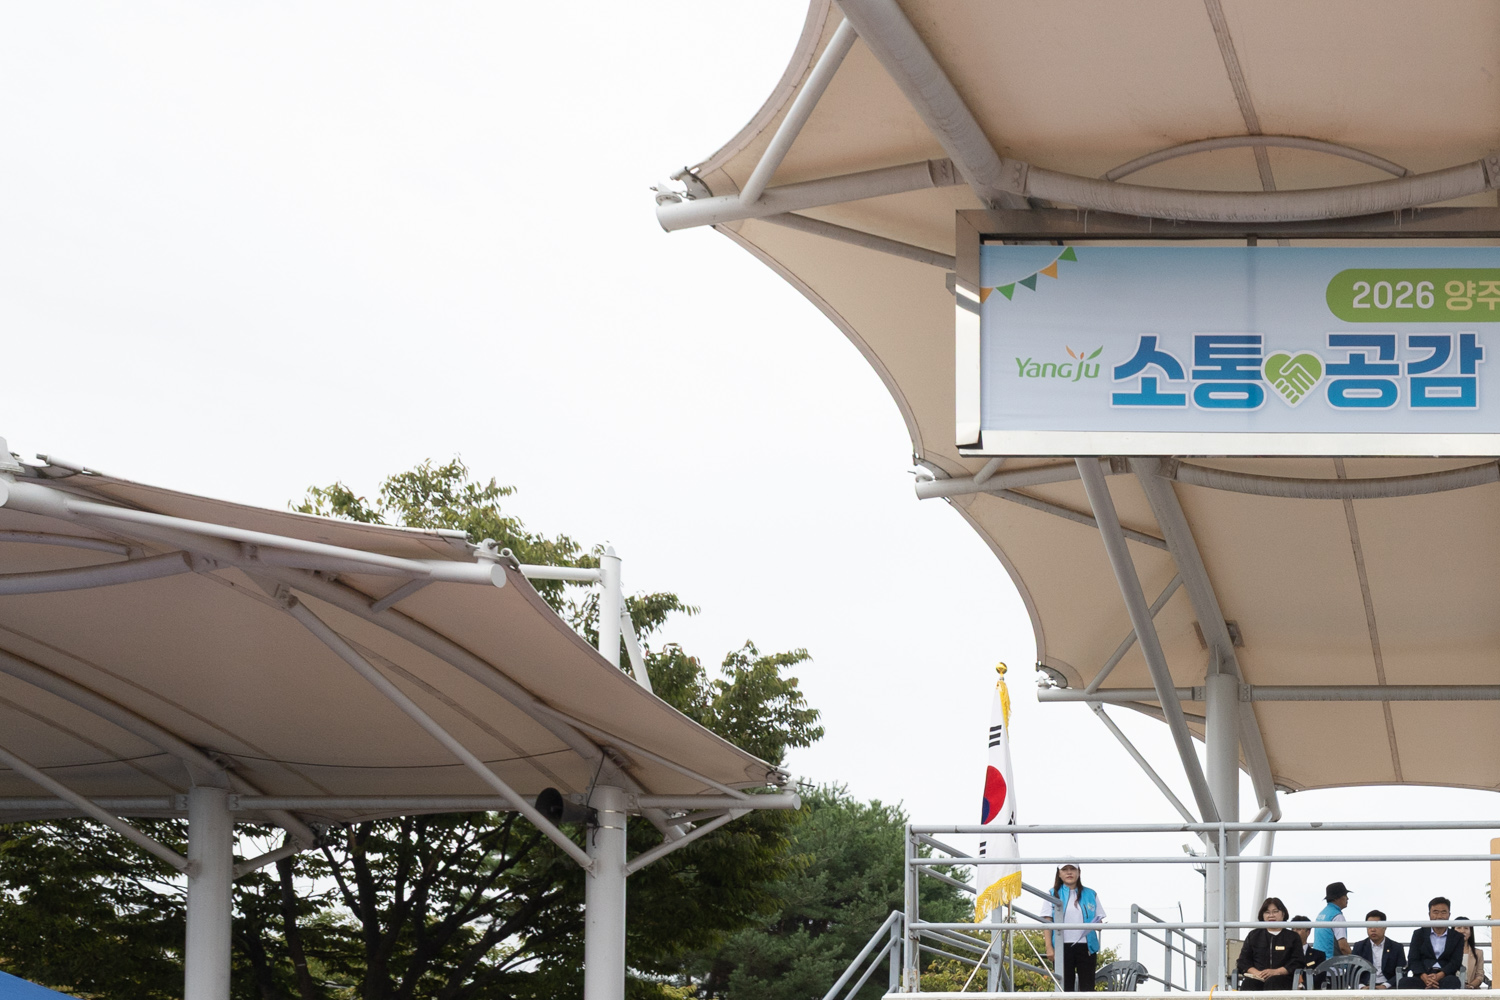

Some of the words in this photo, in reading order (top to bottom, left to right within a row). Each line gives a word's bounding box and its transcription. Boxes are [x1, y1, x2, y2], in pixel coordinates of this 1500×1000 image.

[1352, 280, 1435, 310] 2026
[1015, 356, 1101, 382] Yangju
[1111, 333, 1266, 410] 소통
[1325, 333, 1484, 409] 공감
